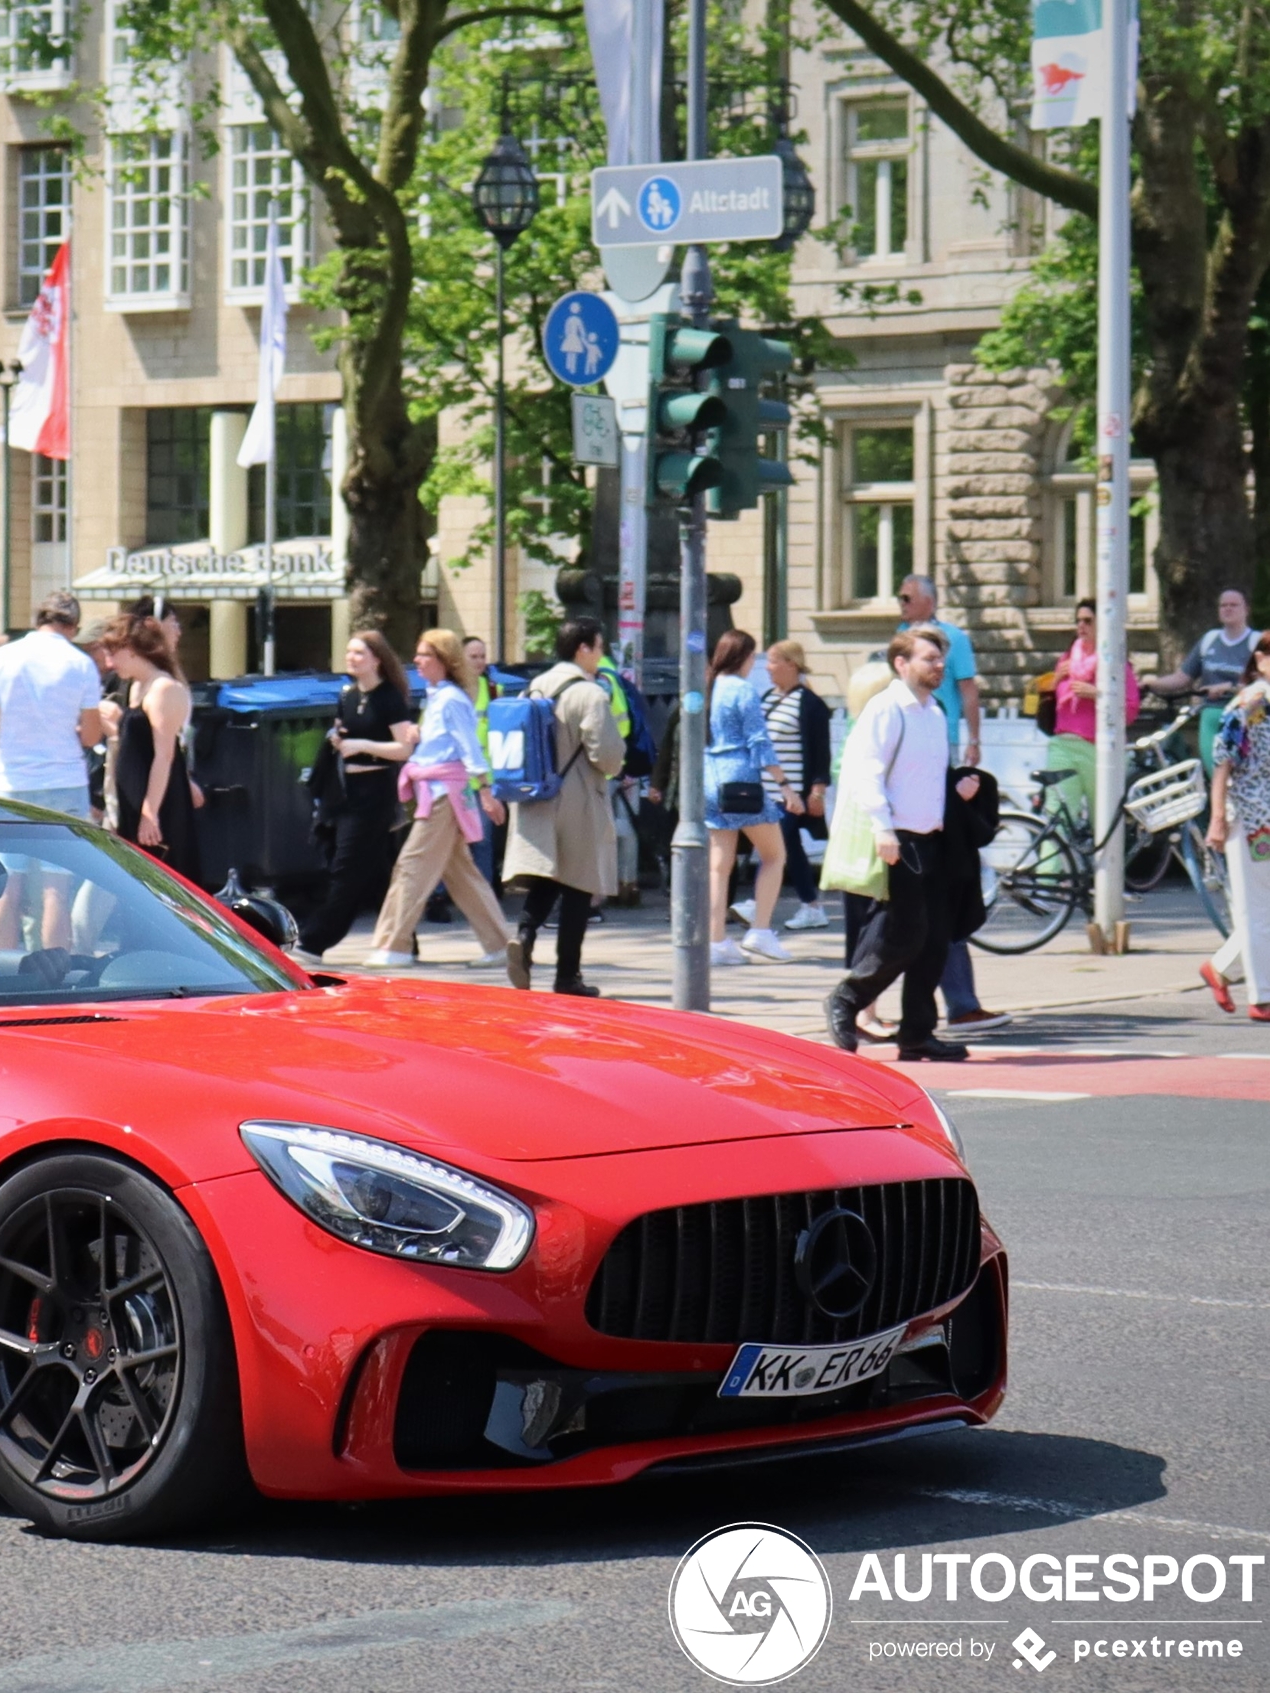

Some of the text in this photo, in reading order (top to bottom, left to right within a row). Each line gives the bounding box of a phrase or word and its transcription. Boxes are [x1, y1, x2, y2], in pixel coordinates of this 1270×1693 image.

[689, 187, 769, 214] Altstadt
[106, 541, 333, 574] Deutsche Bank
[730, 1376, 741, 1388] D
